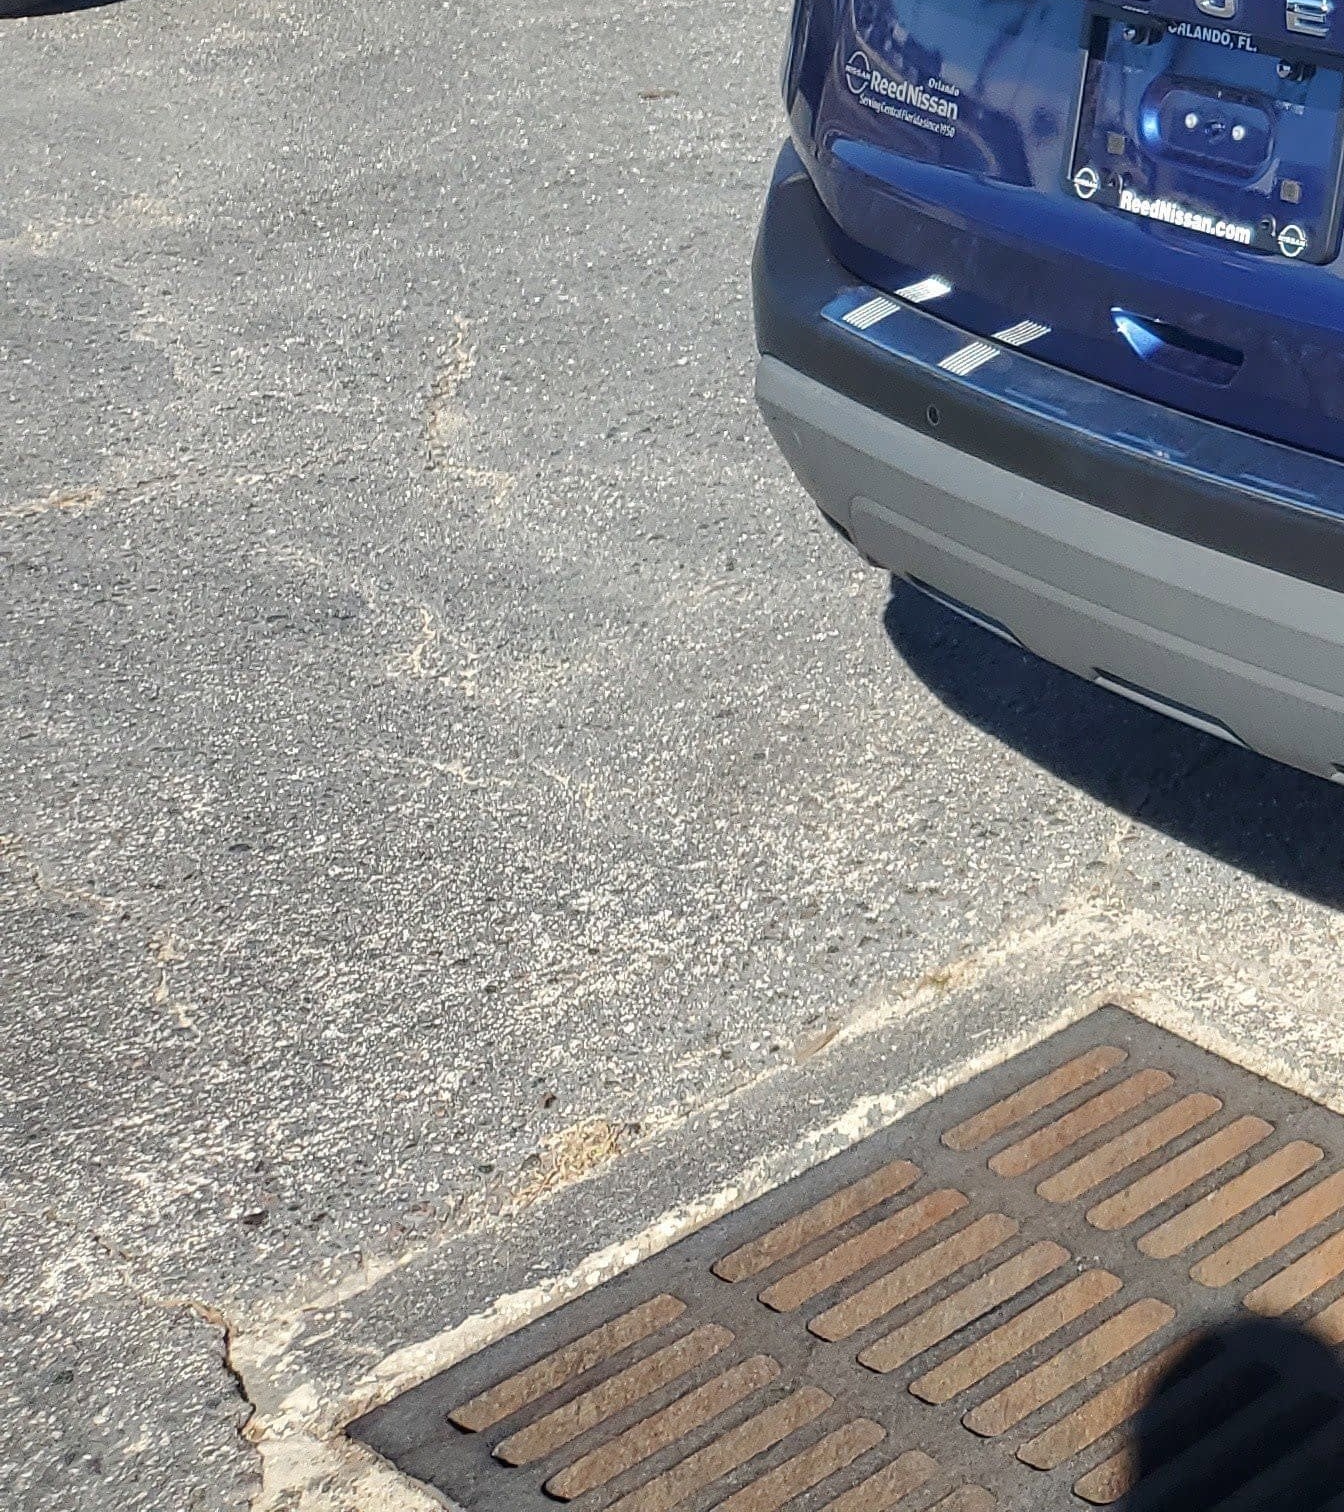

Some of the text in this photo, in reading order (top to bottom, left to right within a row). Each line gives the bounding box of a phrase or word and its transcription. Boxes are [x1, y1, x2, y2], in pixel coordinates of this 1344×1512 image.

[1237, 36, 1258, 53] FL.
[928, 77, 960, 97] Orlando
[1119, 190, 1252, 246] ReedNissan.com
